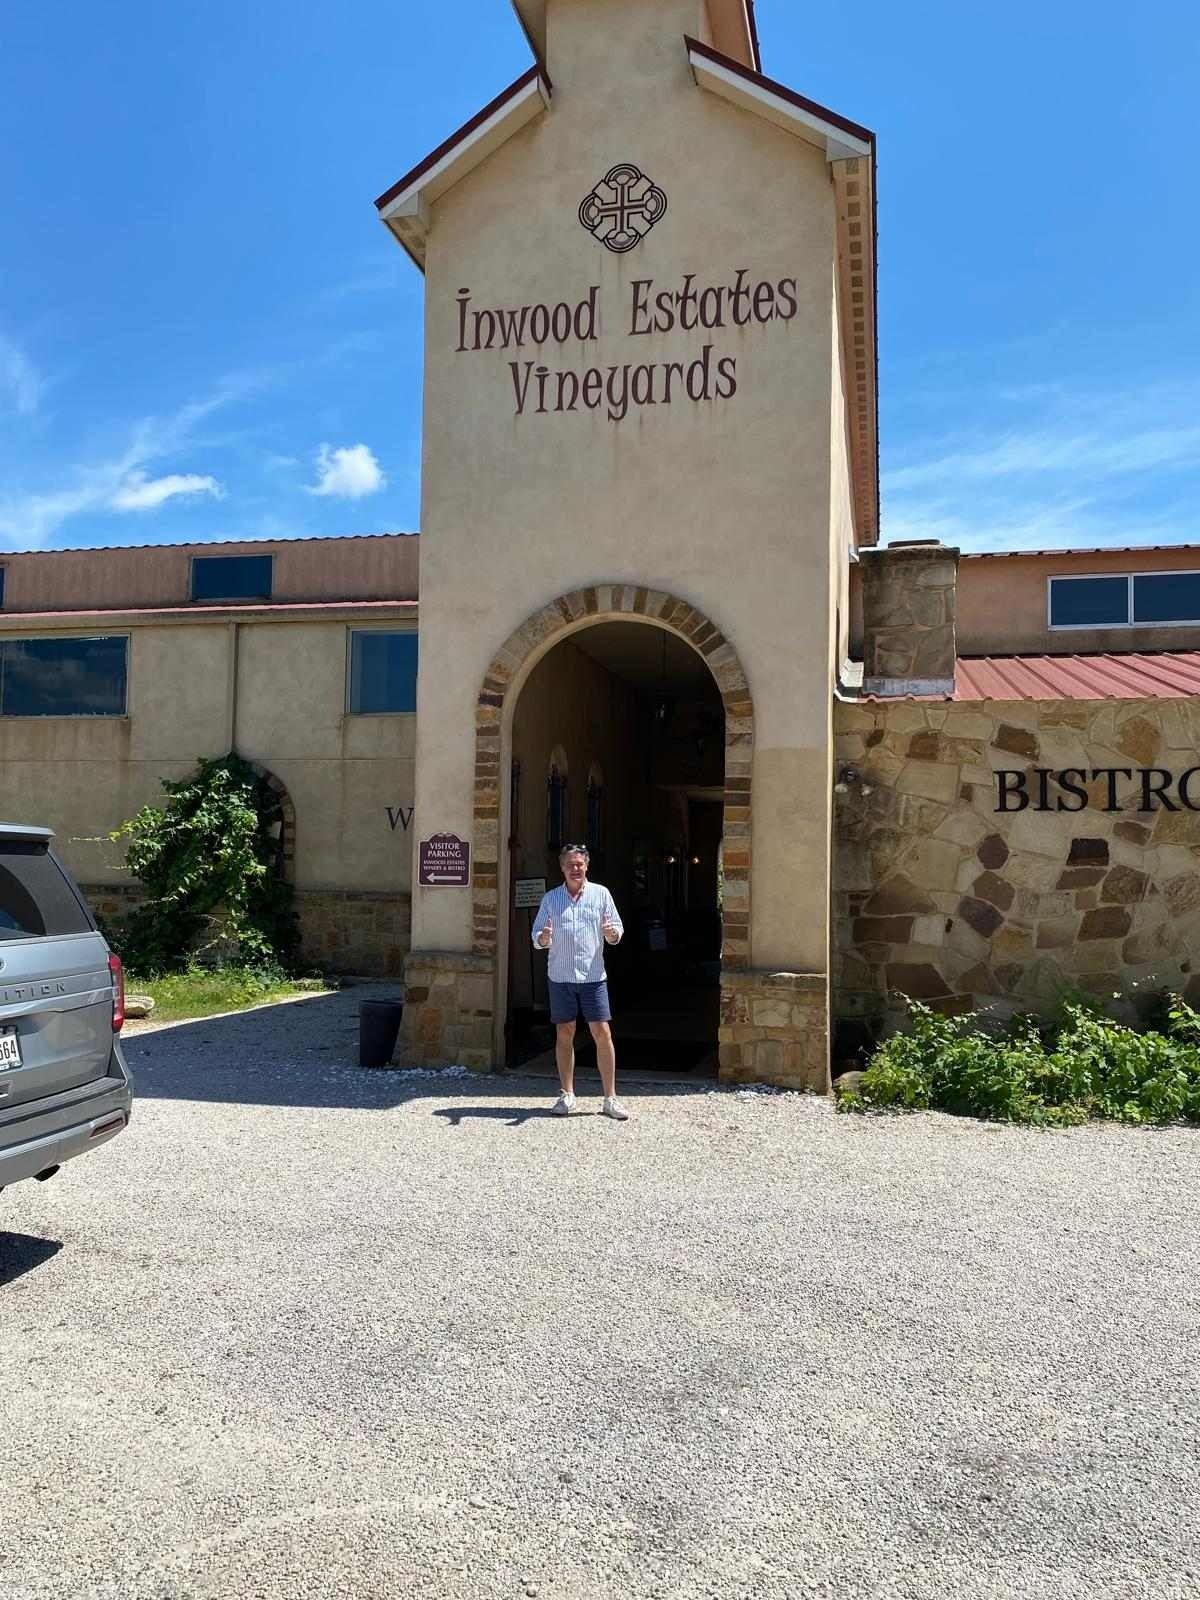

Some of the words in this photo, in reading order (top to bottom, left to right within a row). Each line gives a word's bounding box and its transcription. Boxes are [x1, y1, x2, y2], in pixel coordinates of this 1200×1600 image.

[455, 287, 601, 352] Inwood
[628, 268, 798, 336] Estates
[509, 345, 738, 422] Vineyards
[427, 850, 462, 858] PARKING
[429, 842, 460, 850] VISITOR
